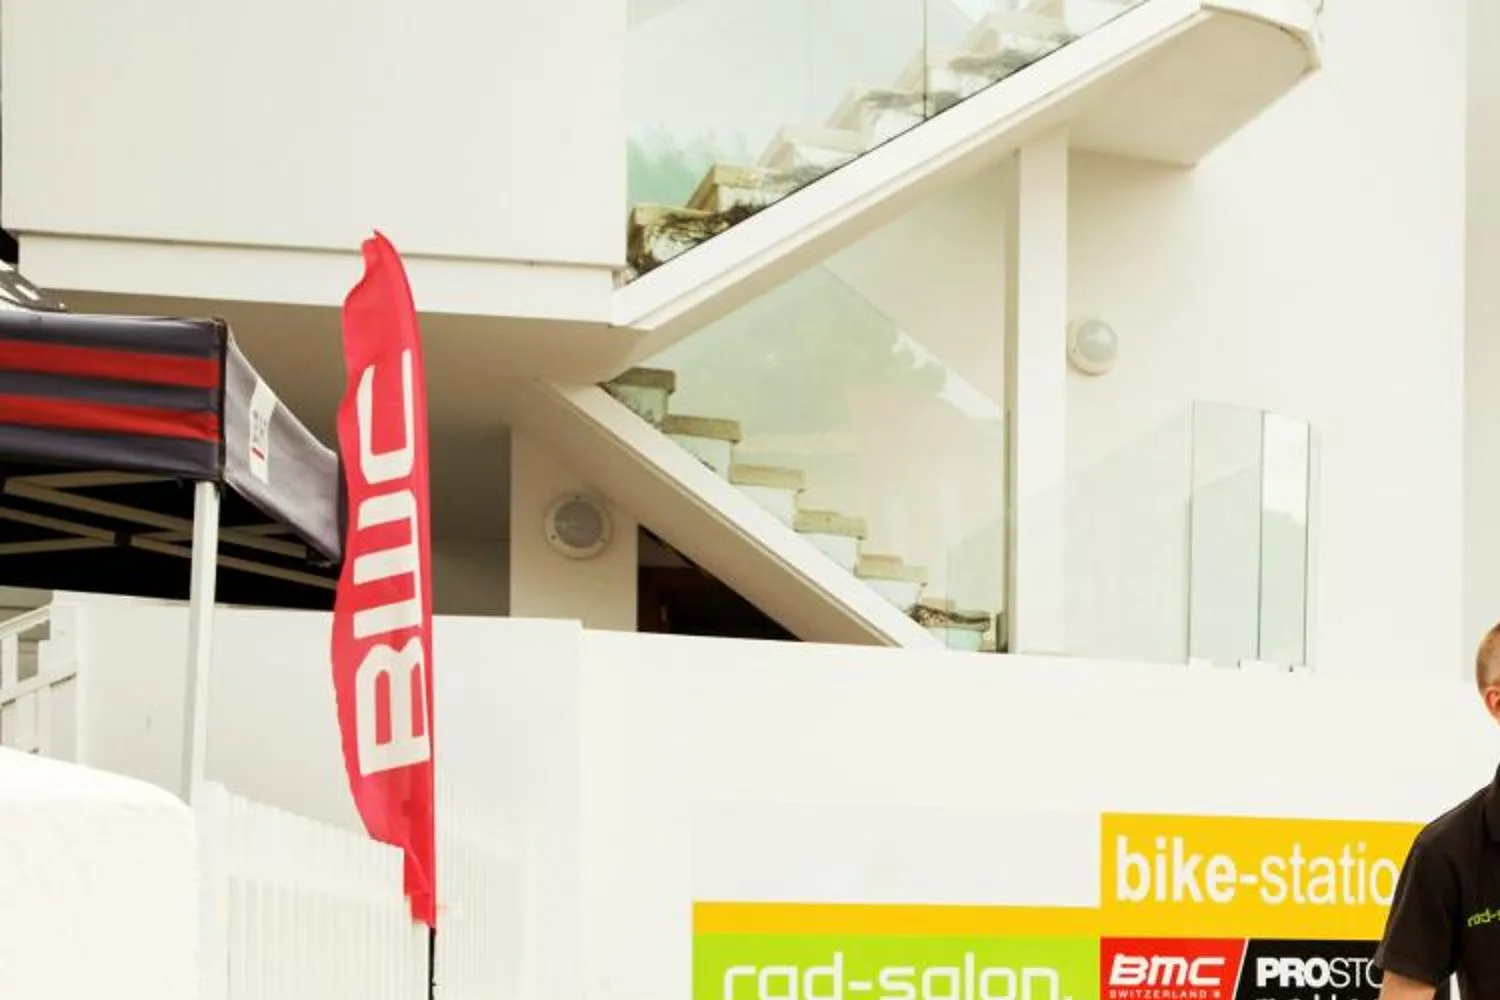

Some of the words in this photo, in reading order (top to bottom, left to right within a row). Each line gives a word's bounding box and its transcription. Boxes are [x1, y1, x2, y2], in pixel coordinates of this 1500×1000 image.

[1116, 834, 1401, 905] bike-statio
[1109, 952, 1226, 986] BMC
[1109, 988, 1207, 999] SWITZERLAND
